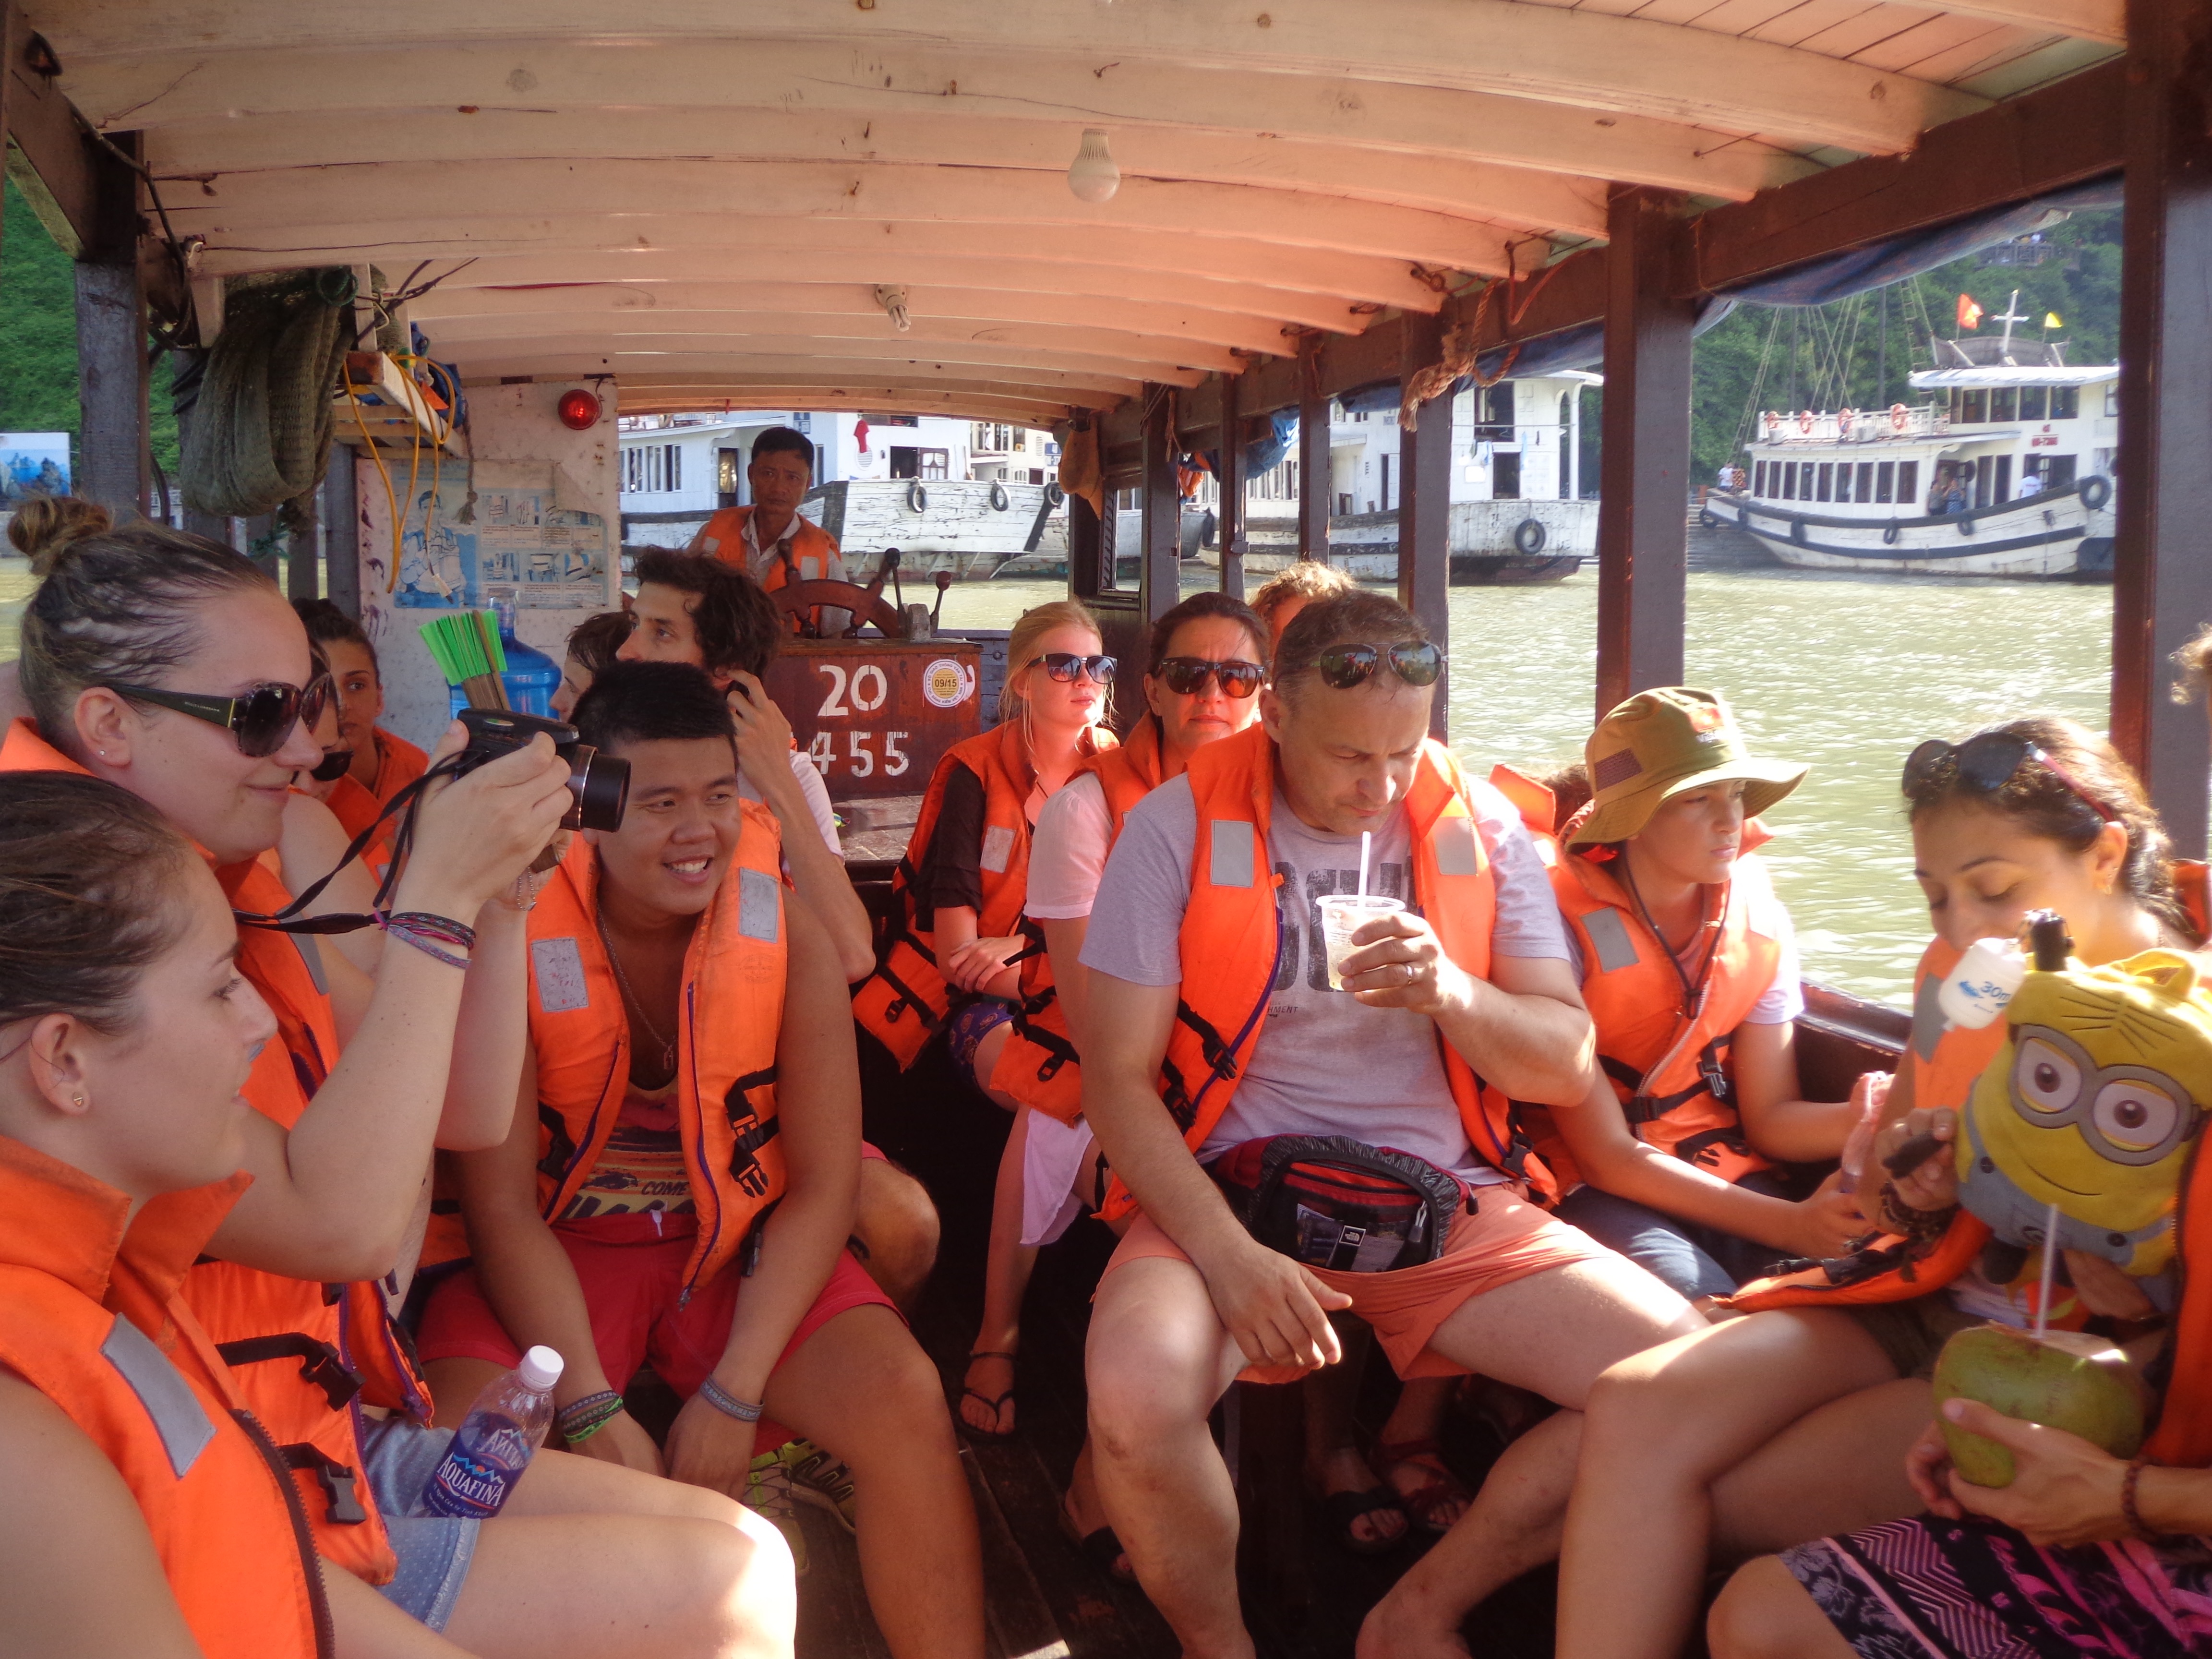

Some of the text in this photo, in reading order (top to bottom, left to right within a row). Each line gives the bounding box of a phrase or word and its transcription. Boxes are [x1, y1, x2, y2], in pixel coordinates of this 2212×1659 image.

[817, 664, 888, 716] 20
[935, 679, 957, 687] 09/15
[437, 1452, 506, 1506] AQUAFINA
